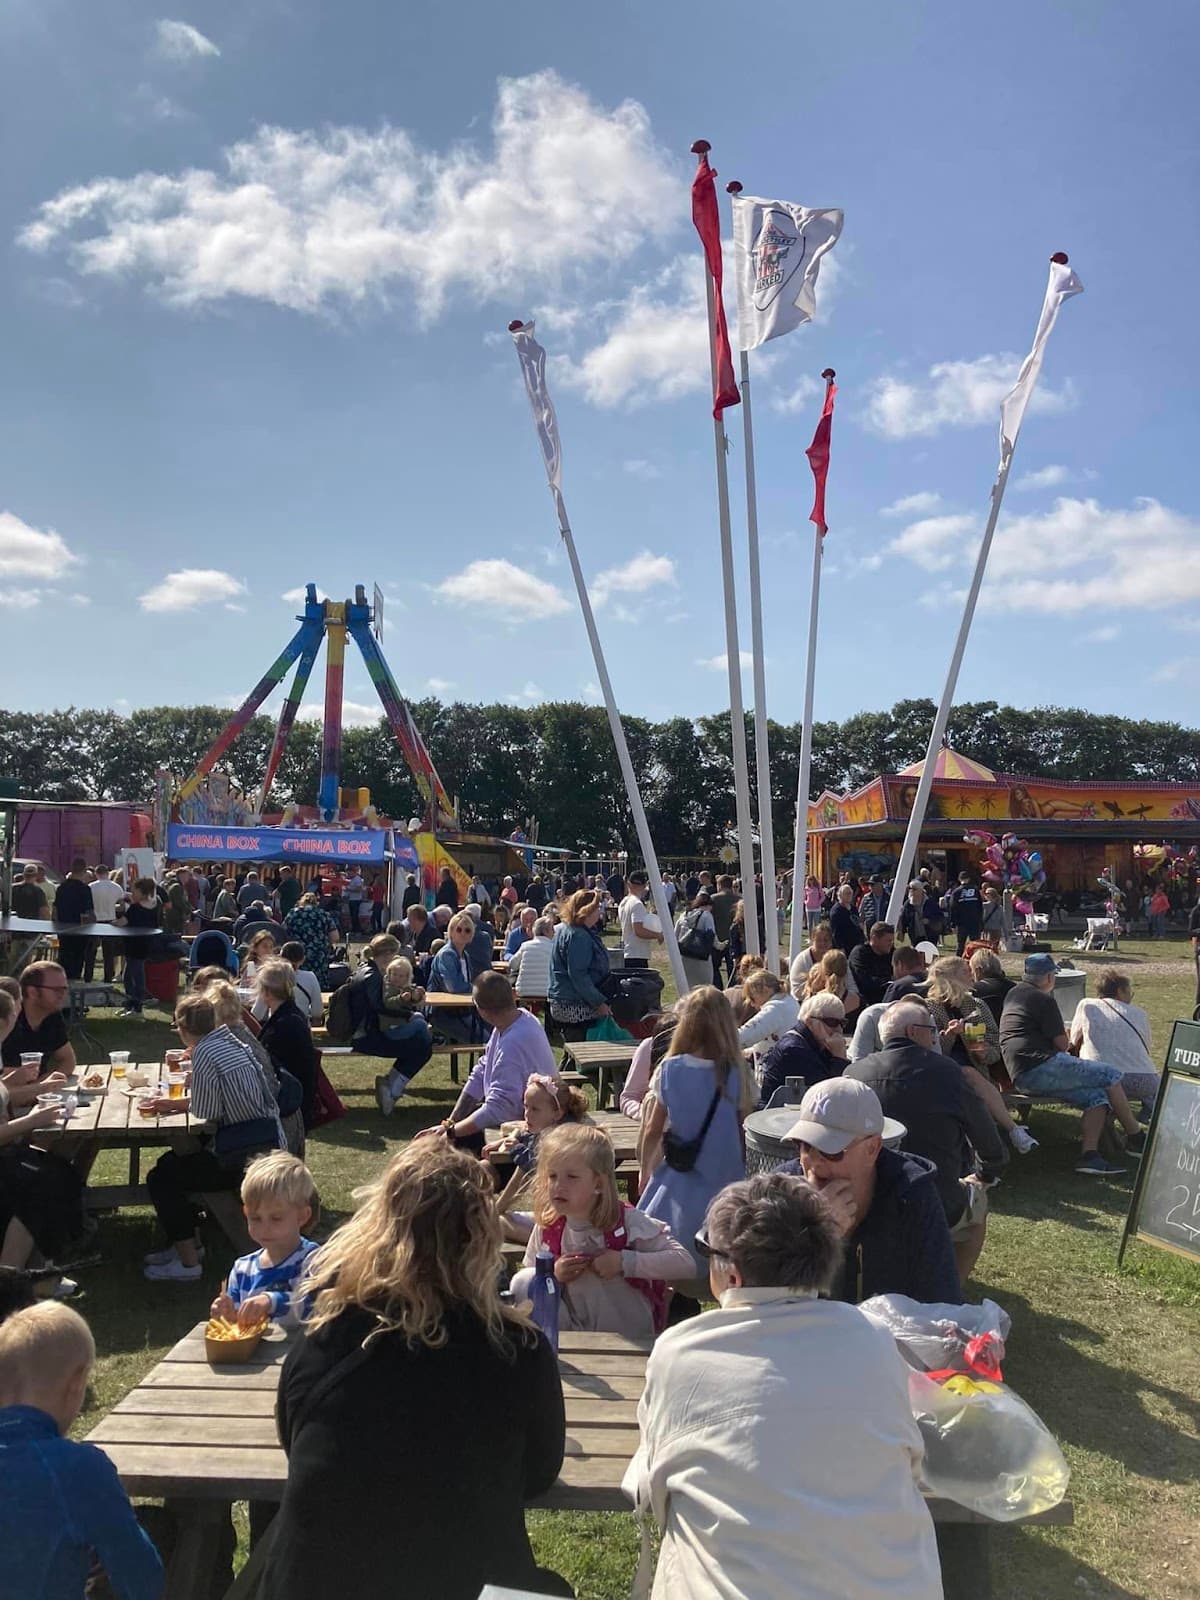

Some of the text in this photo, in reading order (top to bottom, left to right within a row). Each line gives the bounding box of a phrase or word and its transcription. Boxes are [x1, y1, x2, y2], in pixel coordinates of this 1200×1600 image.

[176, 834, 259, 850] CHINA BOX
[282, 839, 371, 854] CHINA BOX
[809, 1093, 830, 1116] NY
